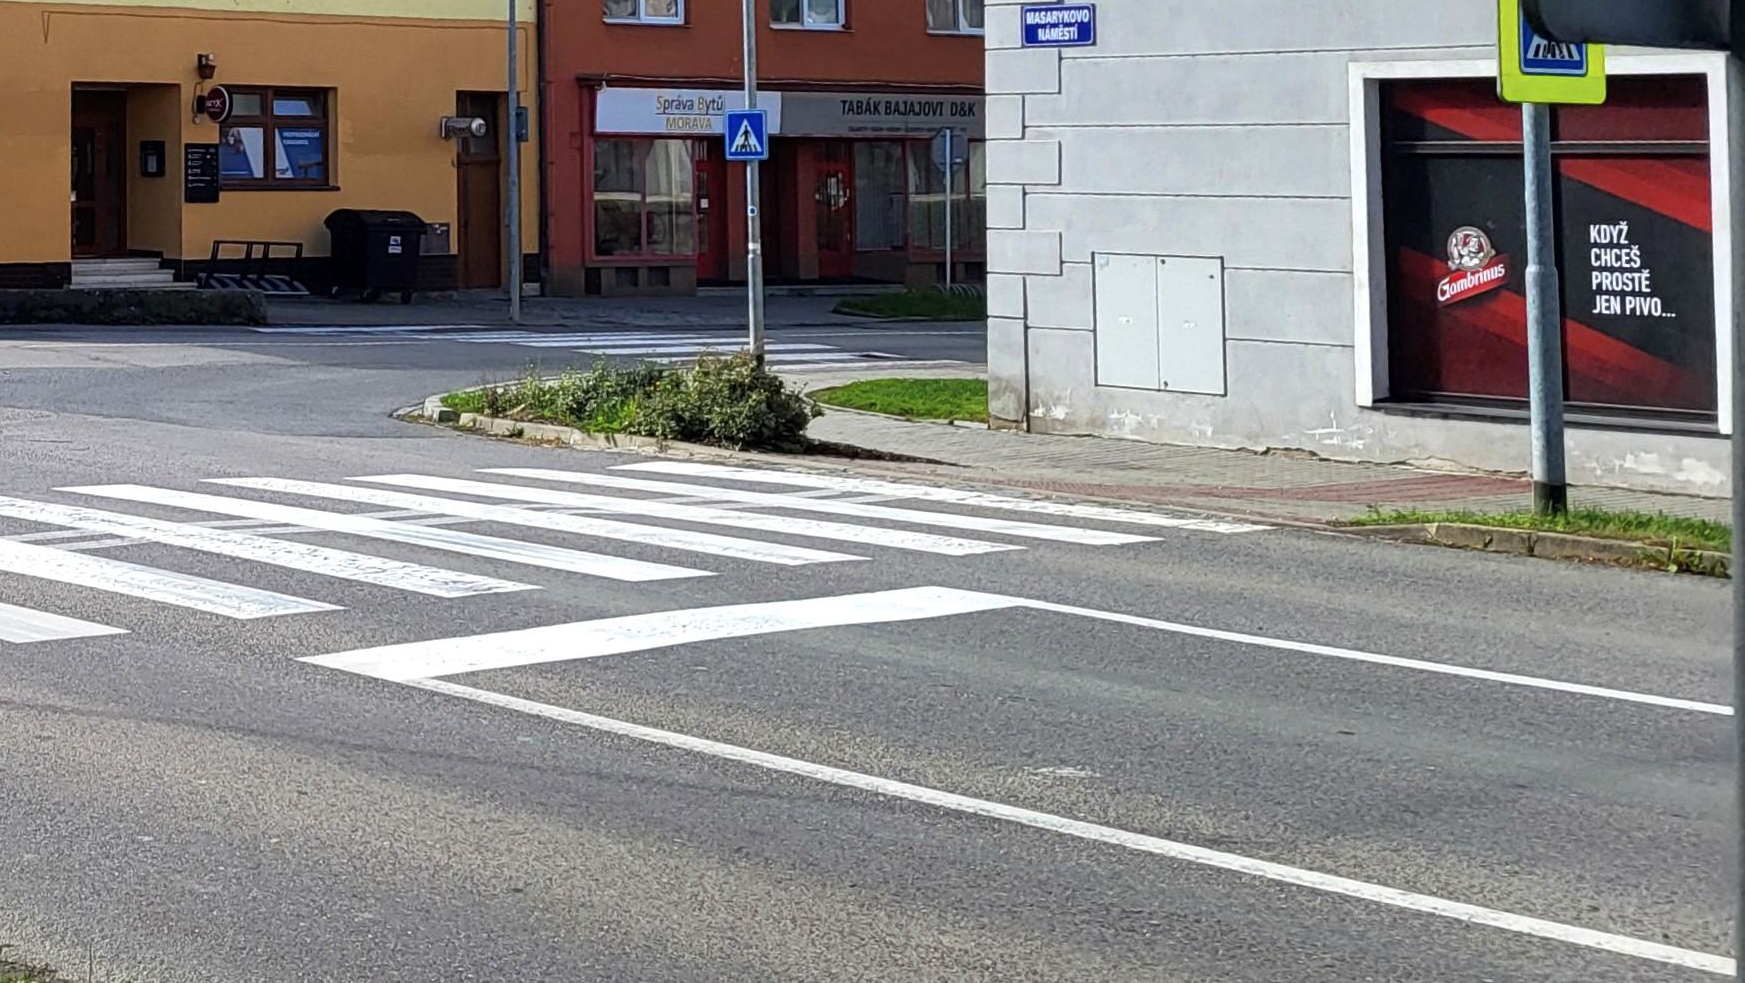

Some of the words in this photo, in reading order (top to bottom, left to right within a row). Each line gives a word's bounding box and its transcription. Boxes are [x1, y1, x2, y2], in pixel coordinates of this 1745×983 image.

[1026, 9, 1090, 24] MASARYKOVO
[1038, 24, 1078, 41] NÁMĚSTÍ
[656, 94, 694, 114] Správa
[697, 95, 724, 114] Bytů
[840, 97, 881, 115] TABÁK
[884, 100, 944, 117] BAJAJOVI
[950, 101, 975, 117] D&K
[666, 117, 712, 130] MORAVA
[1590, 221, 1629, 244] KDYŽ
[1591, 245, 1641, 268] CHCEŠ
[1437, 263, 1505, 302] Gambrinus
[1591, 269, 1651, 292] PROSTĚ
[1592, 295, 1621, 315] JEN
[1625, 296, 1676, 317] PIVO...
